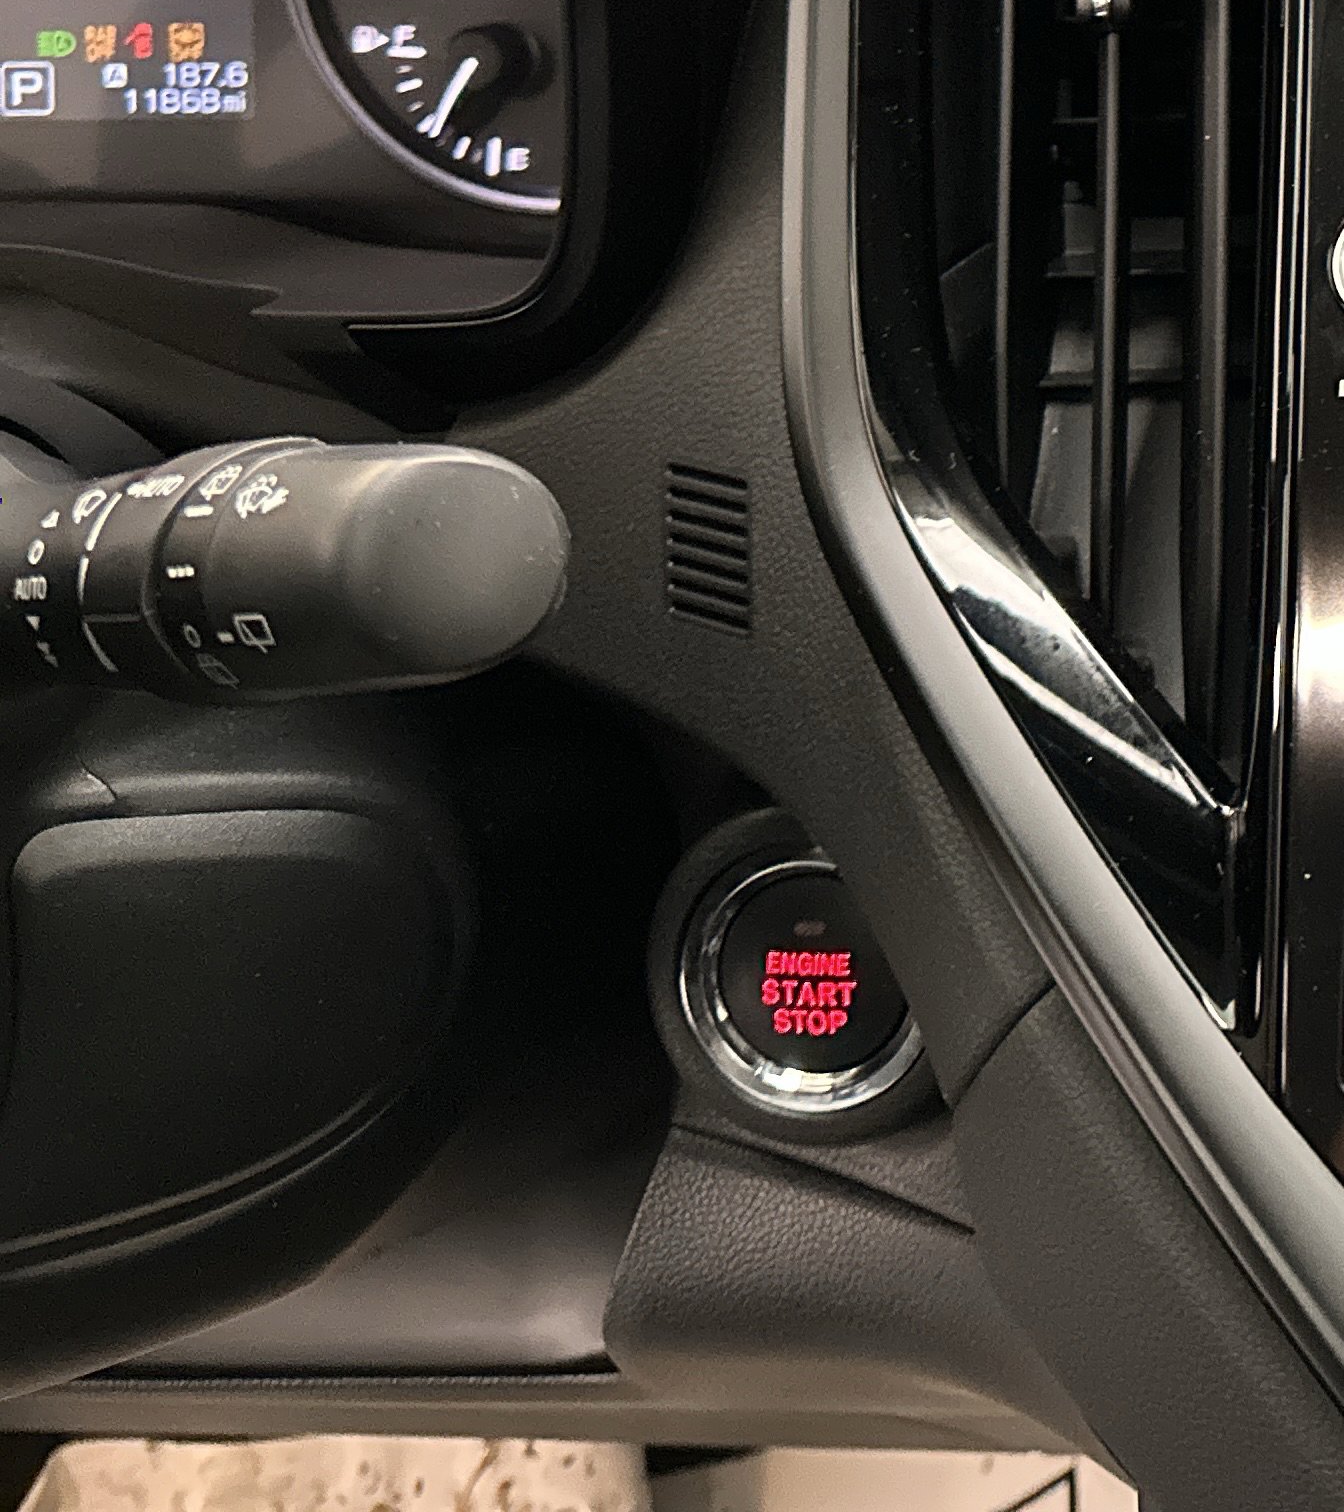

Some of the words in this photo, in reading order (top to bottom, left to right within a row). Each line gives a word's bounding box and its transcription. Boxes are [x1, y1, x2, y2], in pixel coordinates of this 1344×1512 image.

[162, 60, 249, 88] 187.6
[9, 70, 43, 106] P
[504, 147, 531, 172] E
[766, 951, 851, 976] ENGINE
[761, 979, 857, 1007] START
[773, 1009, 848, 1035] STOP
